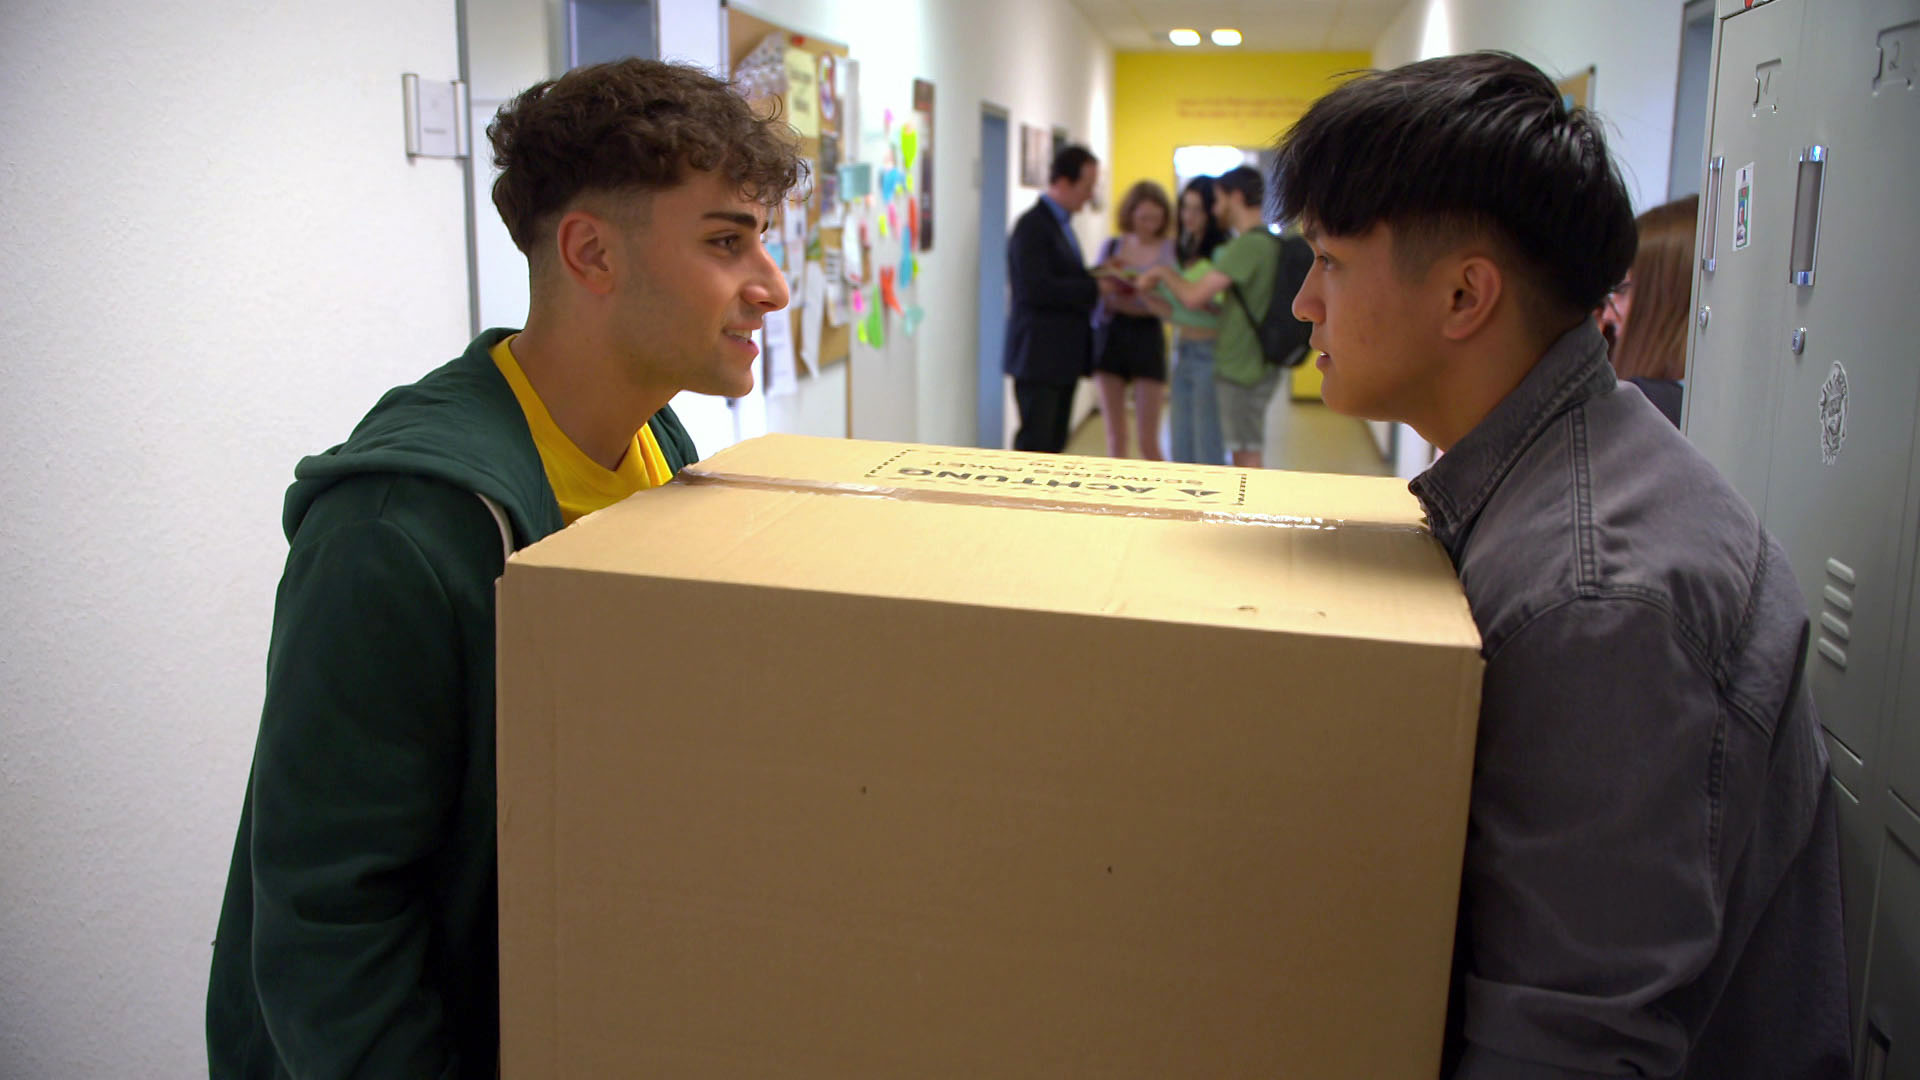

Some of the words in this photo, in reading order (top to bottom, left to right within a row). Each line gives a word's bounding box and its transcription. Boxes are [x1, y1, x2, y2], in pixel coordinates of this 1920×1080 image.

[928, 461, 1023, 472] PAKET
[899, 467, 1157, 493] ACHTUNG
[1033, 469, 1203, 485] SCHWERES
